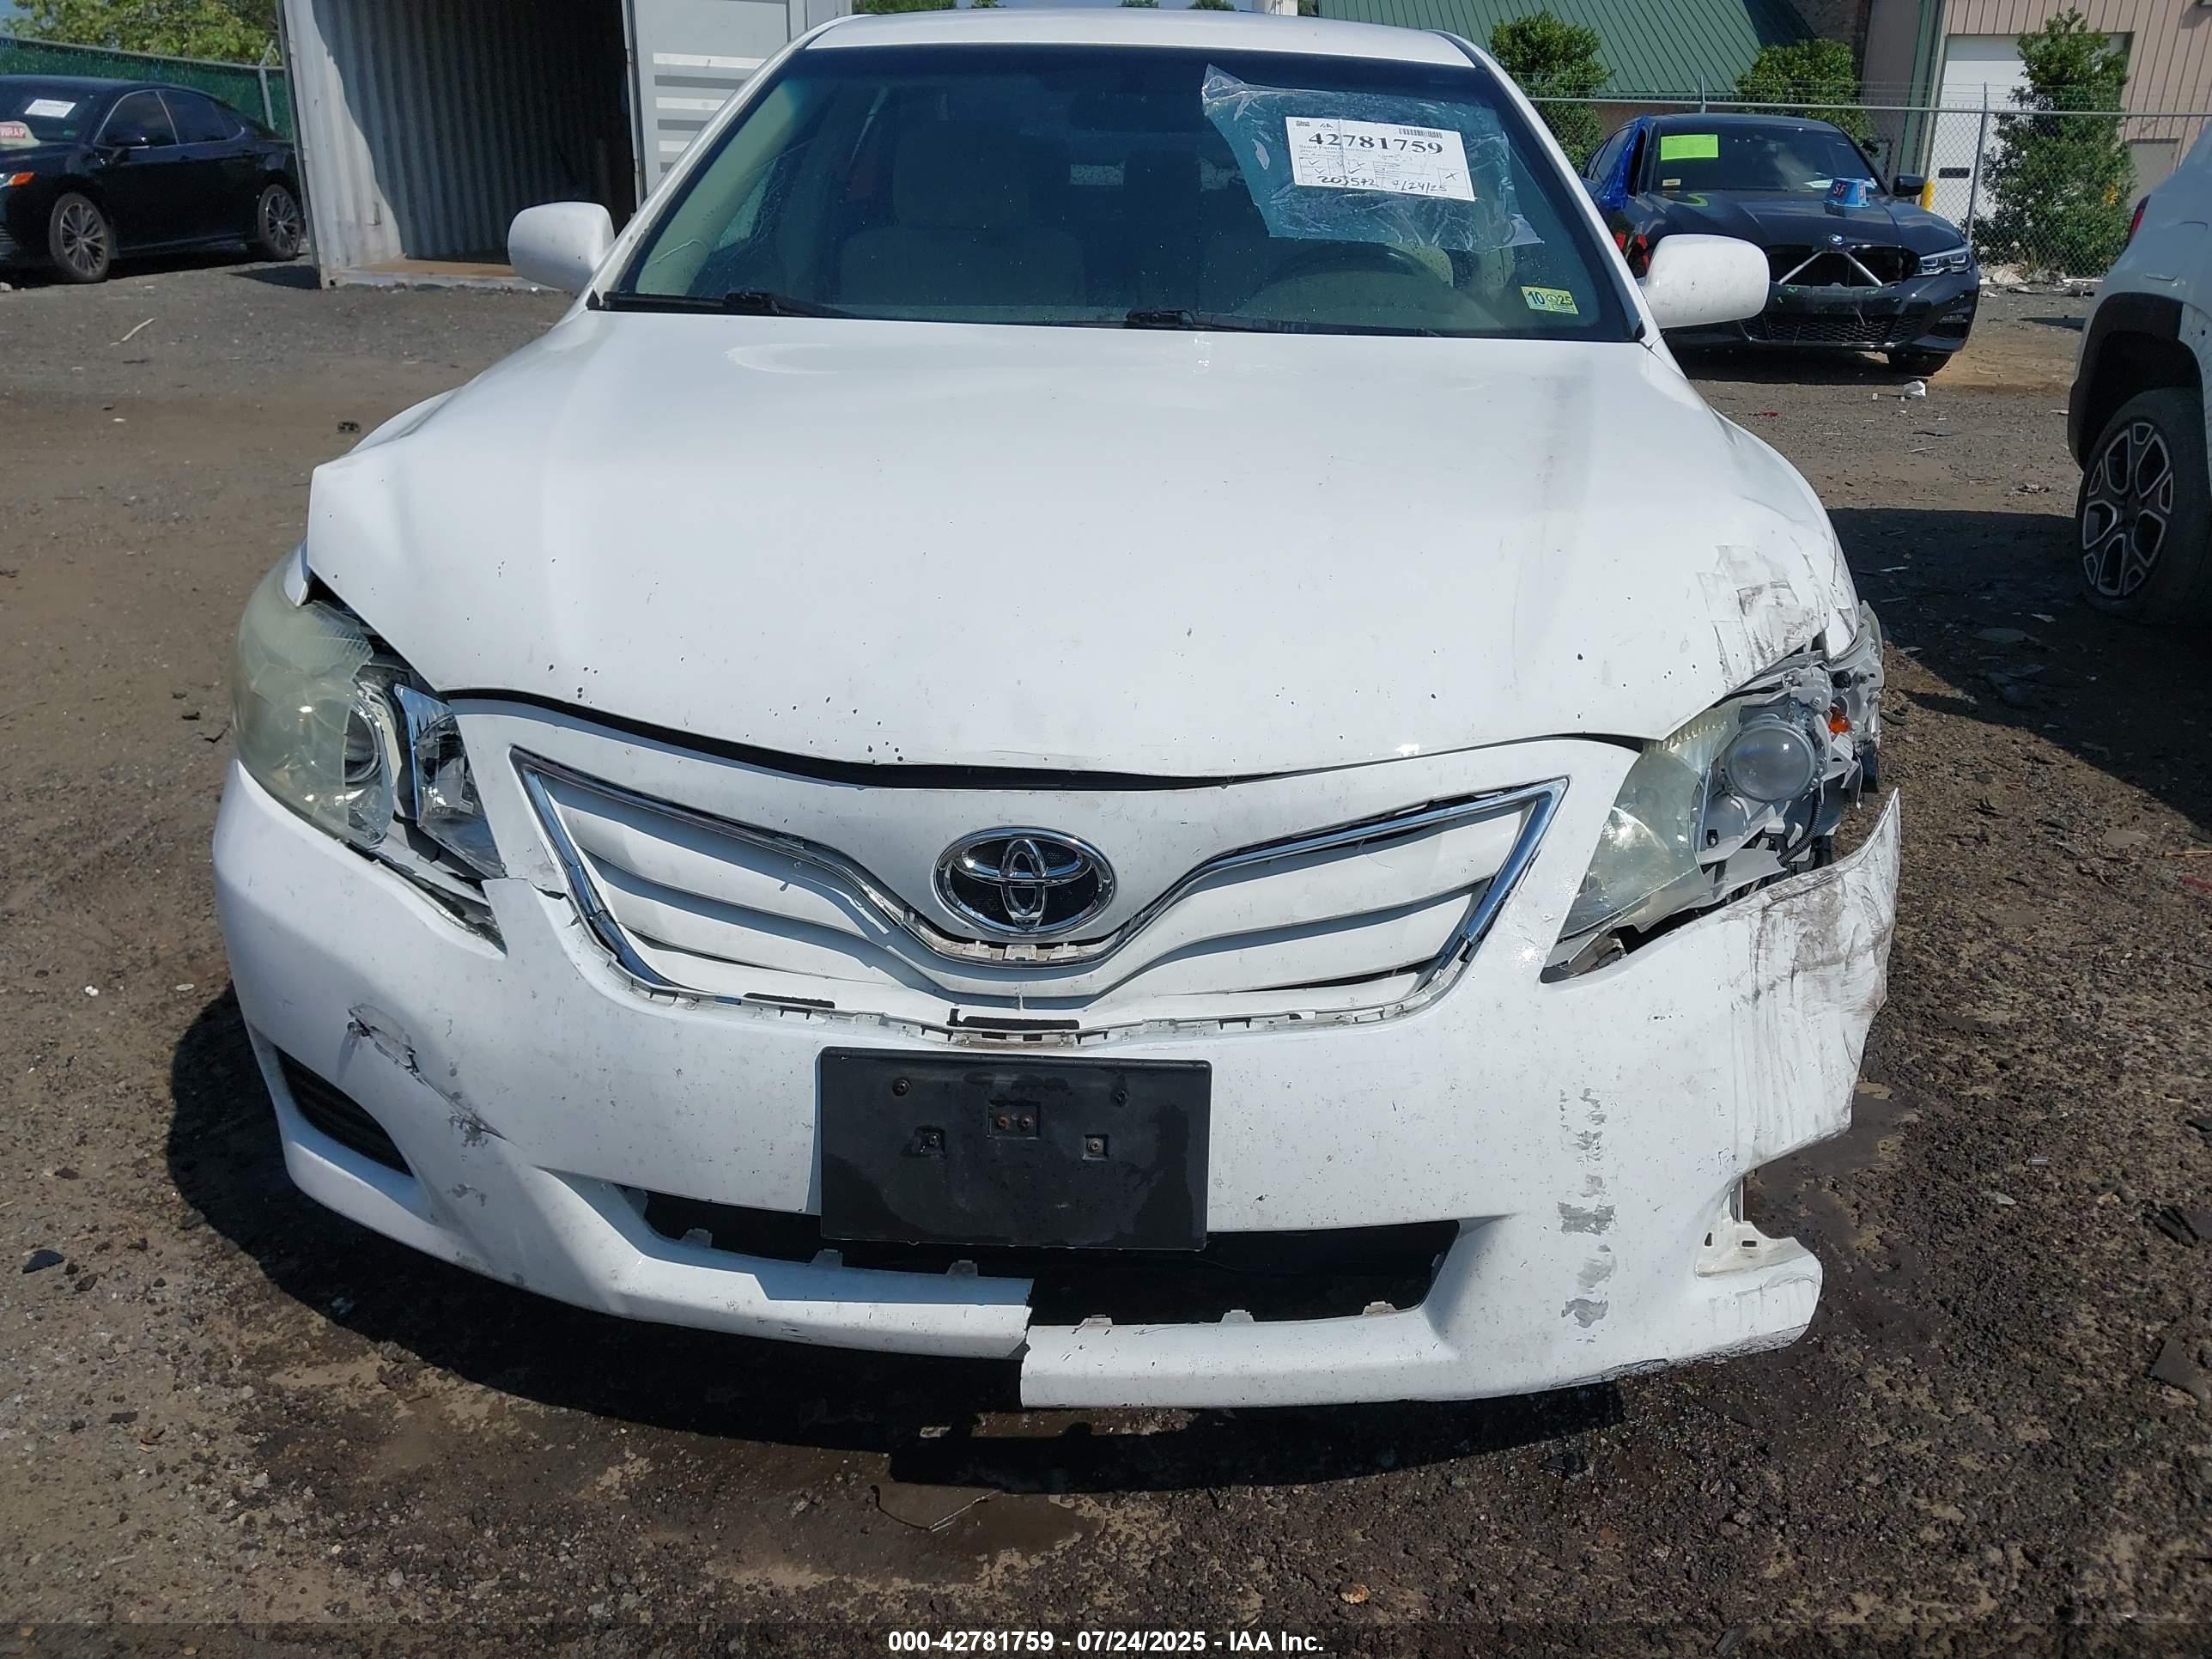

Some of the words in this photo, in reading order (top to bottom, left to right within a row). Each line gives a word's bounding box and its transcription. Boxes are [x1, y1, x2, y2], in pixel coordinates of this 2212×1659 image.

[1308, 132, 1443, 155] 42781759
[1528, 291, 1545, 304] 10
[1558, 295, 1573, 305] 25
